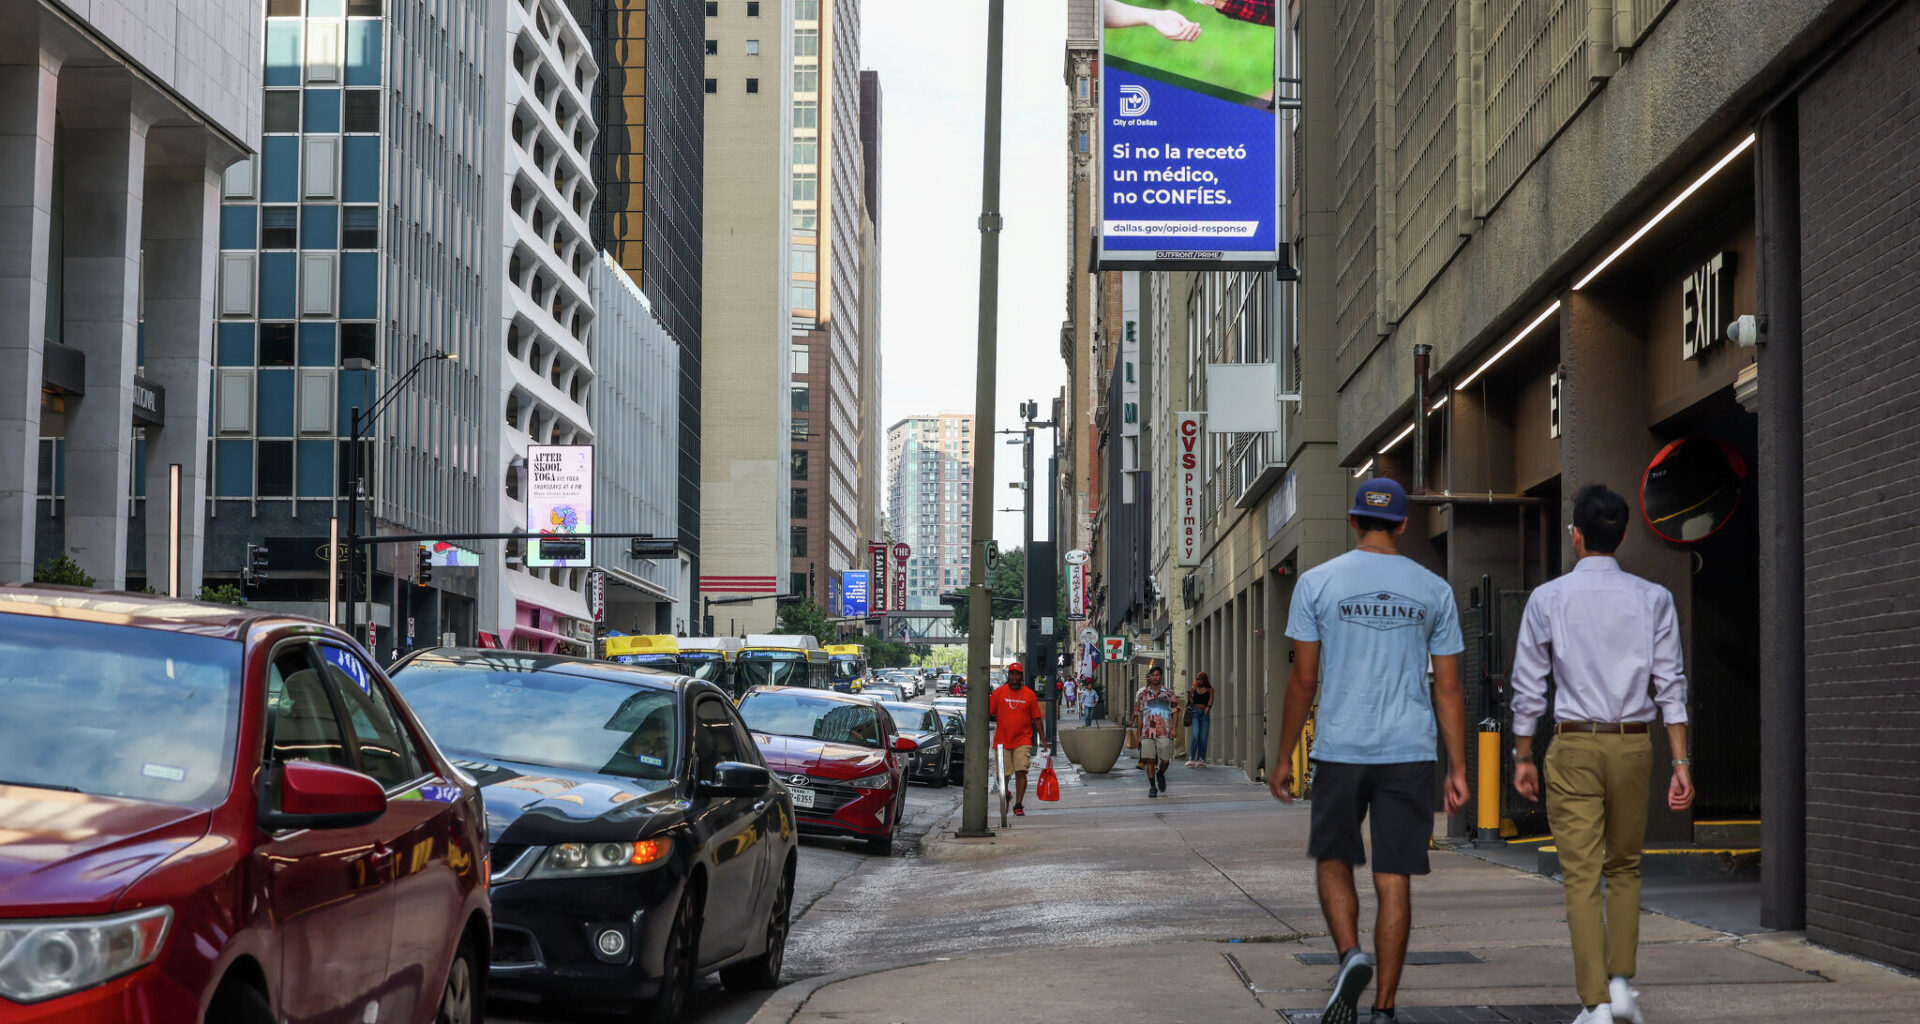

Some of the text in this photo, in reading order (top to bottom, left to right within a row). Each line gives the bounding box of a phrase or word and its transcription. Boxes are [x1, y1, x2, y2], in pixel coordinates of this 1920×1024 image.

[1113, 119, 1126, 127] City
[1113, 143, 1247, 159] Si no la recetó
[1113, 166, 1219, 185] un médico,
[1113, 186, 1232, 205] no CONFÍES.
[1113, 223, 1248, 235] dallas.gov/opioid-response
[1683, 251, 1723, 361] EXIT
[534, 453, 562, 462] AFTER
[534, 463, 562, 472] SKOOL
[534, 472, 556, 481] YOGA
[1180, 419, 1197, 559] CVS pharmacy
[895, 548, 910, 556] THE
[989, 547, 997, 565] P
[875, 588, 884, 609] ELM
[1341, 604, 1425, 620] WAVELINES
[746, 651, 752, 659] 3
[1107, 640, 1122, 660] 7
[617, 655, 633, 663] 305
